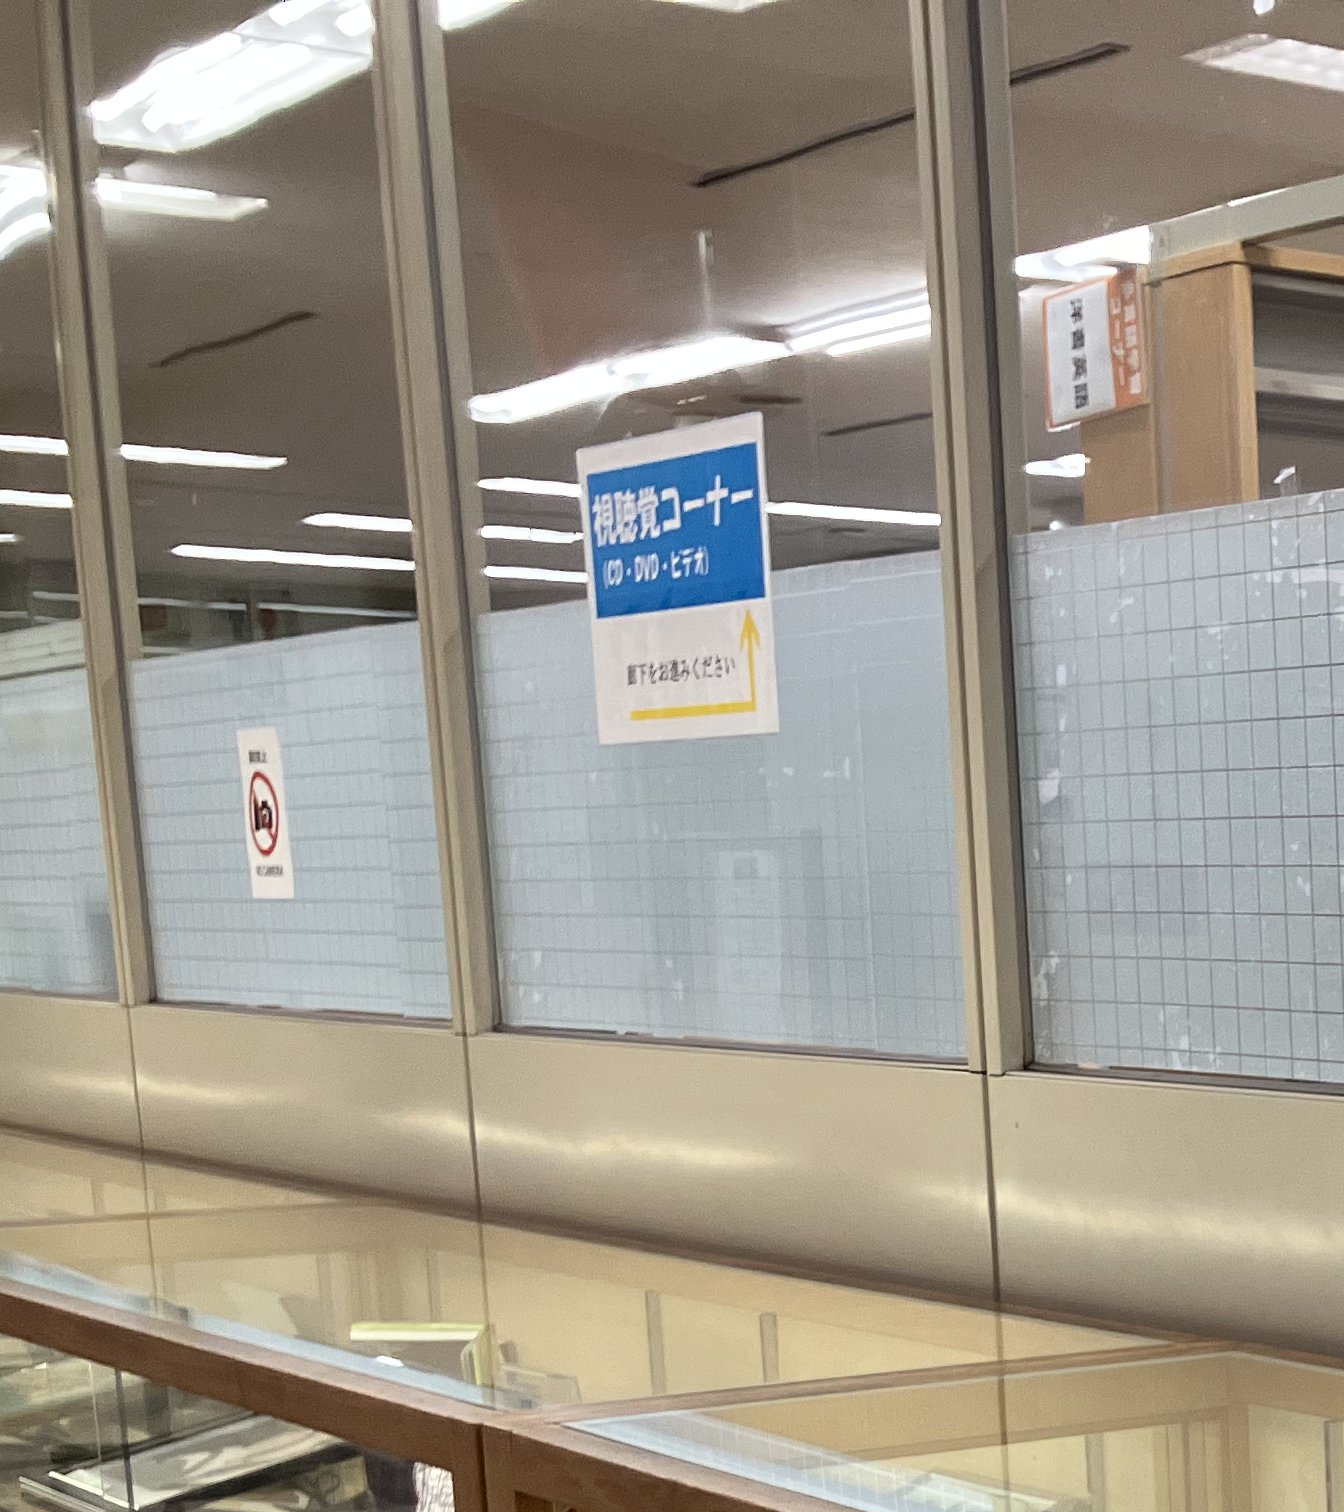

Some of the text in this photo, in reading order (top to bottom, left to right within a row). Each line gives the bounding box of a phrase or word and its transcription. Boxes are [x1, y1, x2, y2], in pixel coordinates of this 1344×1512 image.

[592, 474, 755, 548] 視聴覚コーナー
